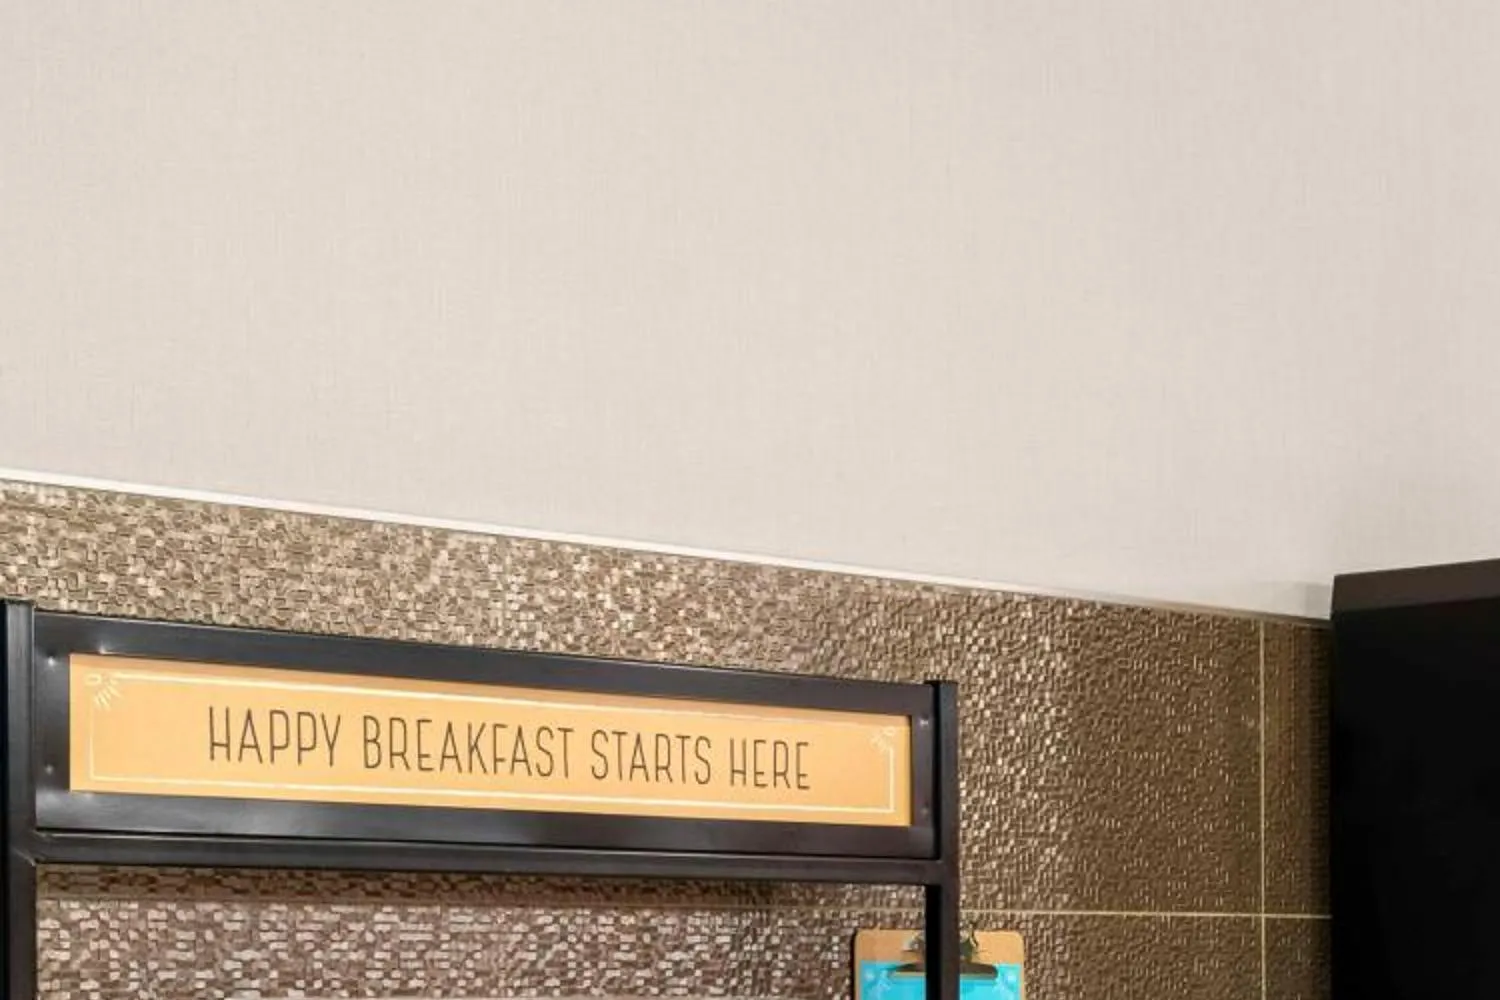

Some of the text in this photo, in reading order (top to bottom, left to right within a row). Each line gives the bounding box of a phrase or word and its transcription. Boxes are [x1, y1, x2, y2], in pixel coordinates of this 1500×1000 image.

[208, 705, 811, 790] HAPPY BREAKFAST STARTS HERE
